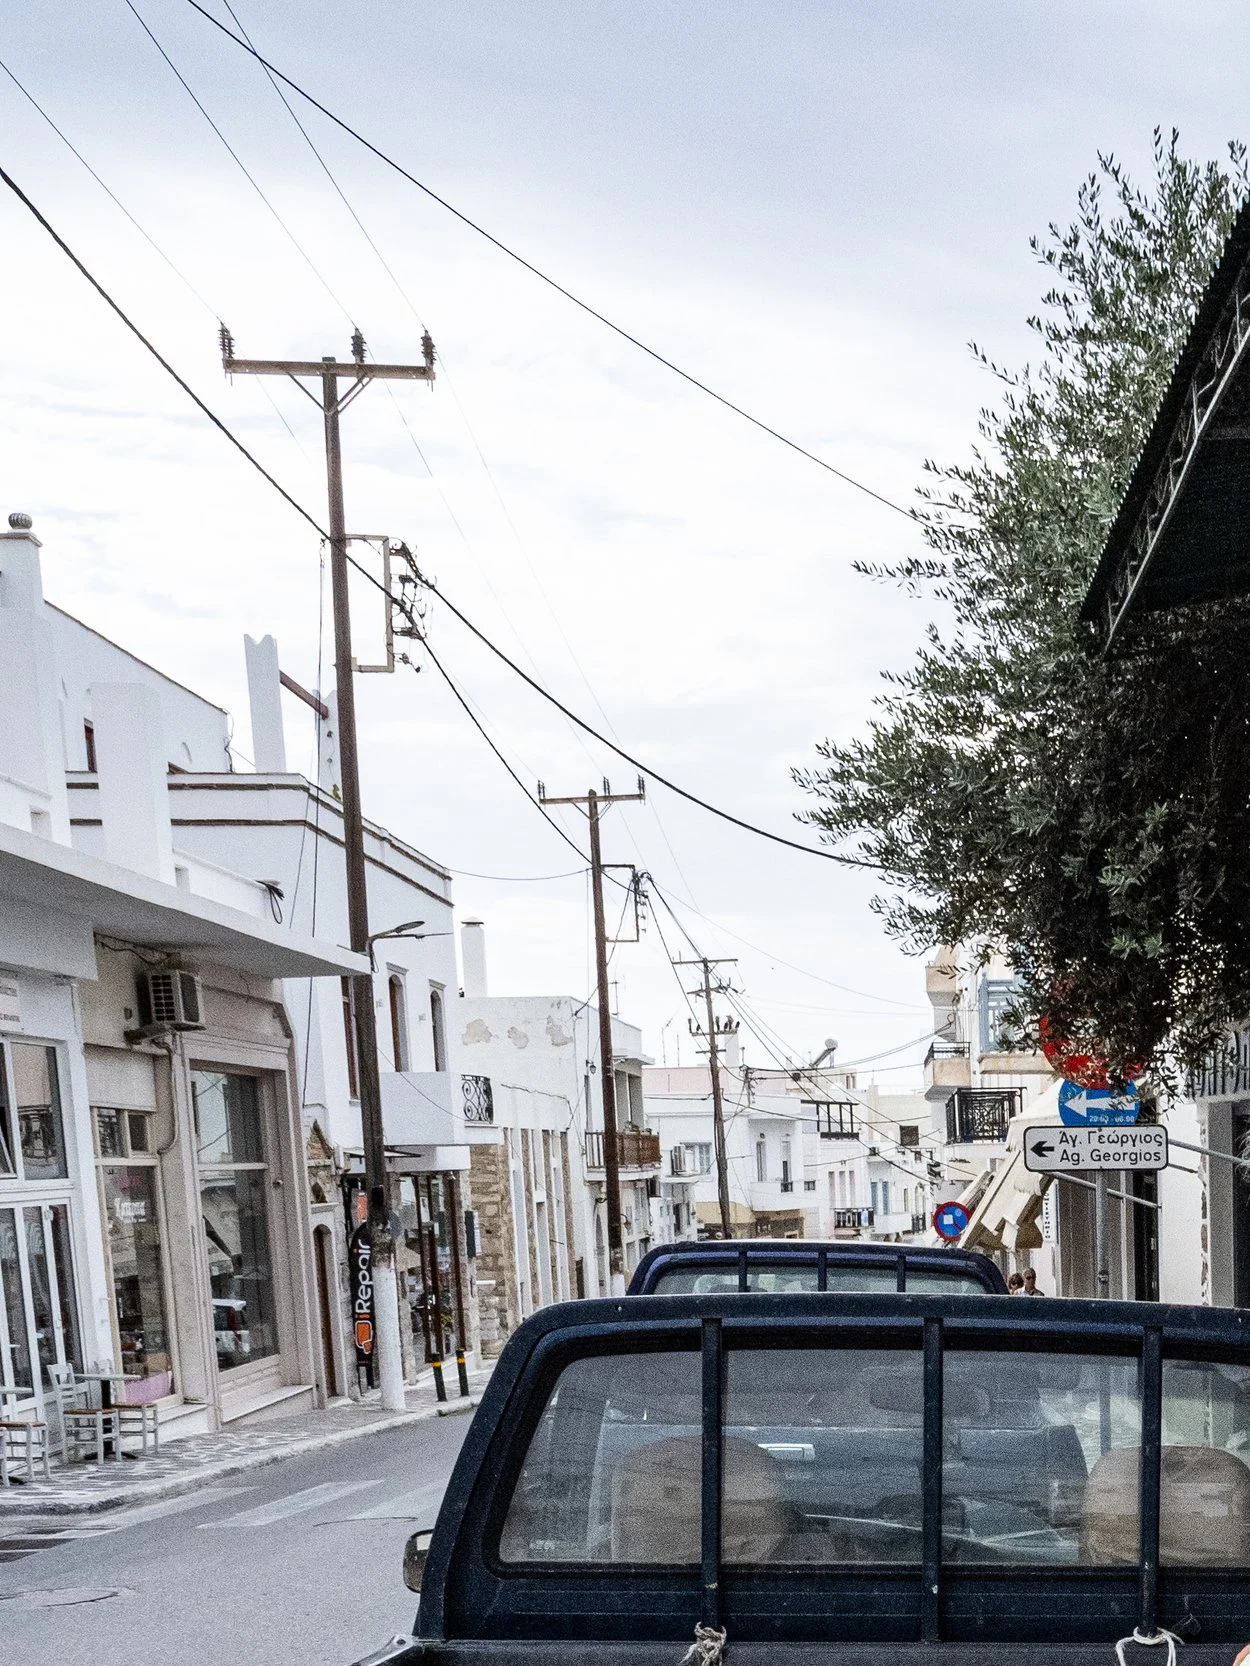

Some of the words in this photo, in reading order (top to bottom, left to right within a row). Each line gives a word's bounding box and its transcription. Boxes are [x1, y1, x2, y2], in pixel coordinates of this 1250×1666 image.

[1059, 1130, 1082, 1147] Άγ.
[1088, 1130, 1163, 1147] Γεώργιος
[1059, 1149, 1084, 1165] Ag.
[1090, 1149, 1161, 1165] Georgios
[353, 1239, 373, 1319] iRepair
